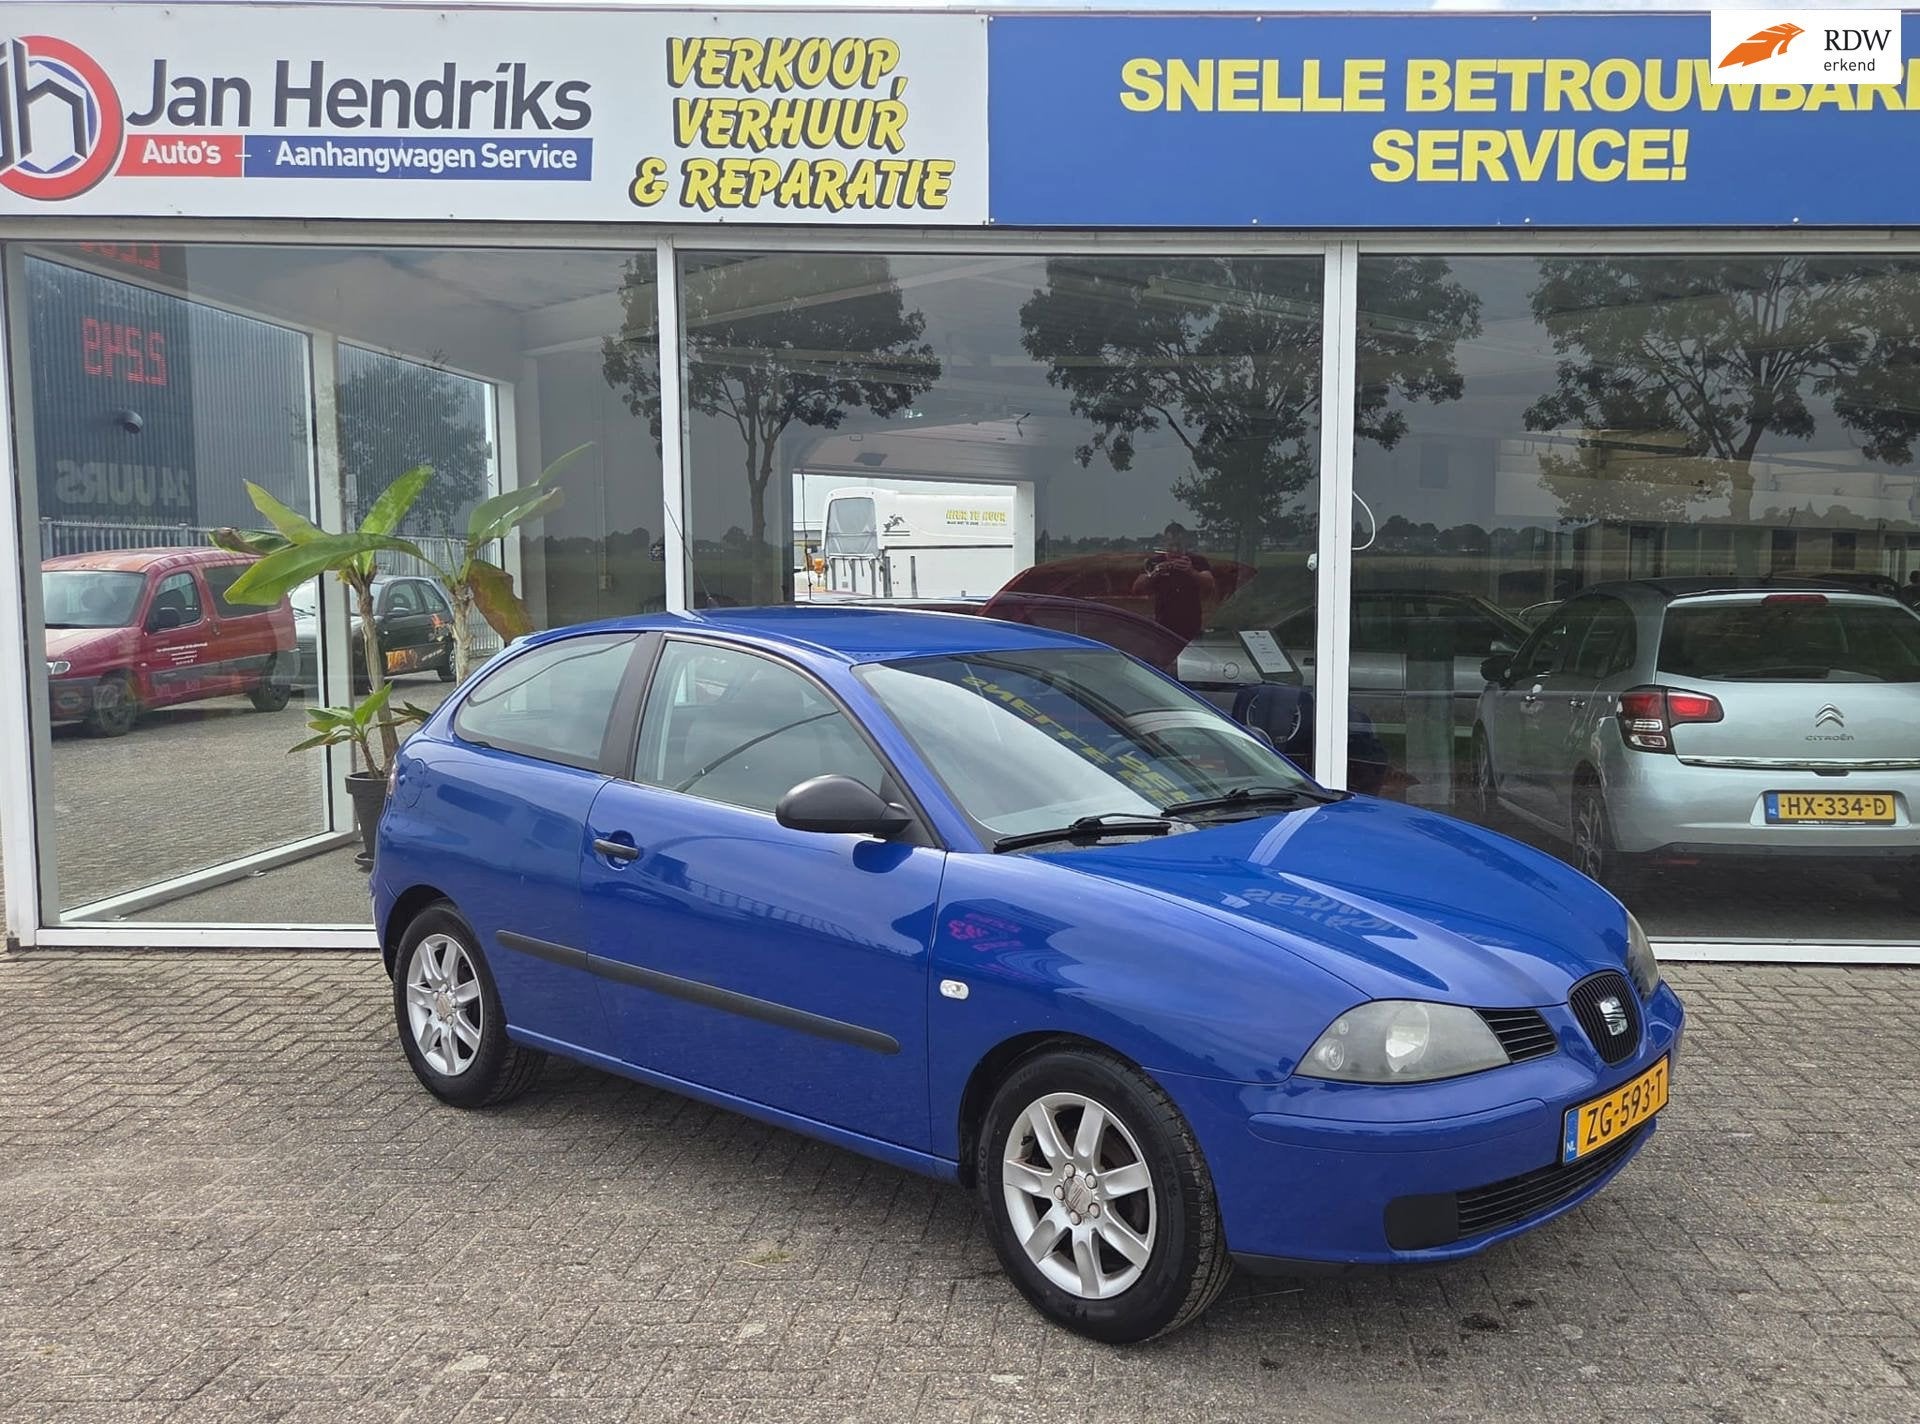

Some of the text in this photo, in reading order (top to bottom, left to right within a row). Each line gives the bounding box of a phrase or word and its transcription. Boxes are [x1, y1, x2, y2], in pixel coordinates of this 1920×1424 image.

[126, 59, 251, 127] Jan
[666, 37, 908, 100] VERKOOP,
[1120, 57, 1386, 113] SNELLE
[673, 98, 908, 154] VERHUUR
[142, 139, 578, 174] Auto's Aanhangwagen Service
[1370, 127, 1690, 182] SERVICE!
[629, 157, 955, 213] & REPARATIE
[1786, 797, 1887, 816] HX-334-D
[1566, 1068, 1664, 1152] NL ZG-593-T
